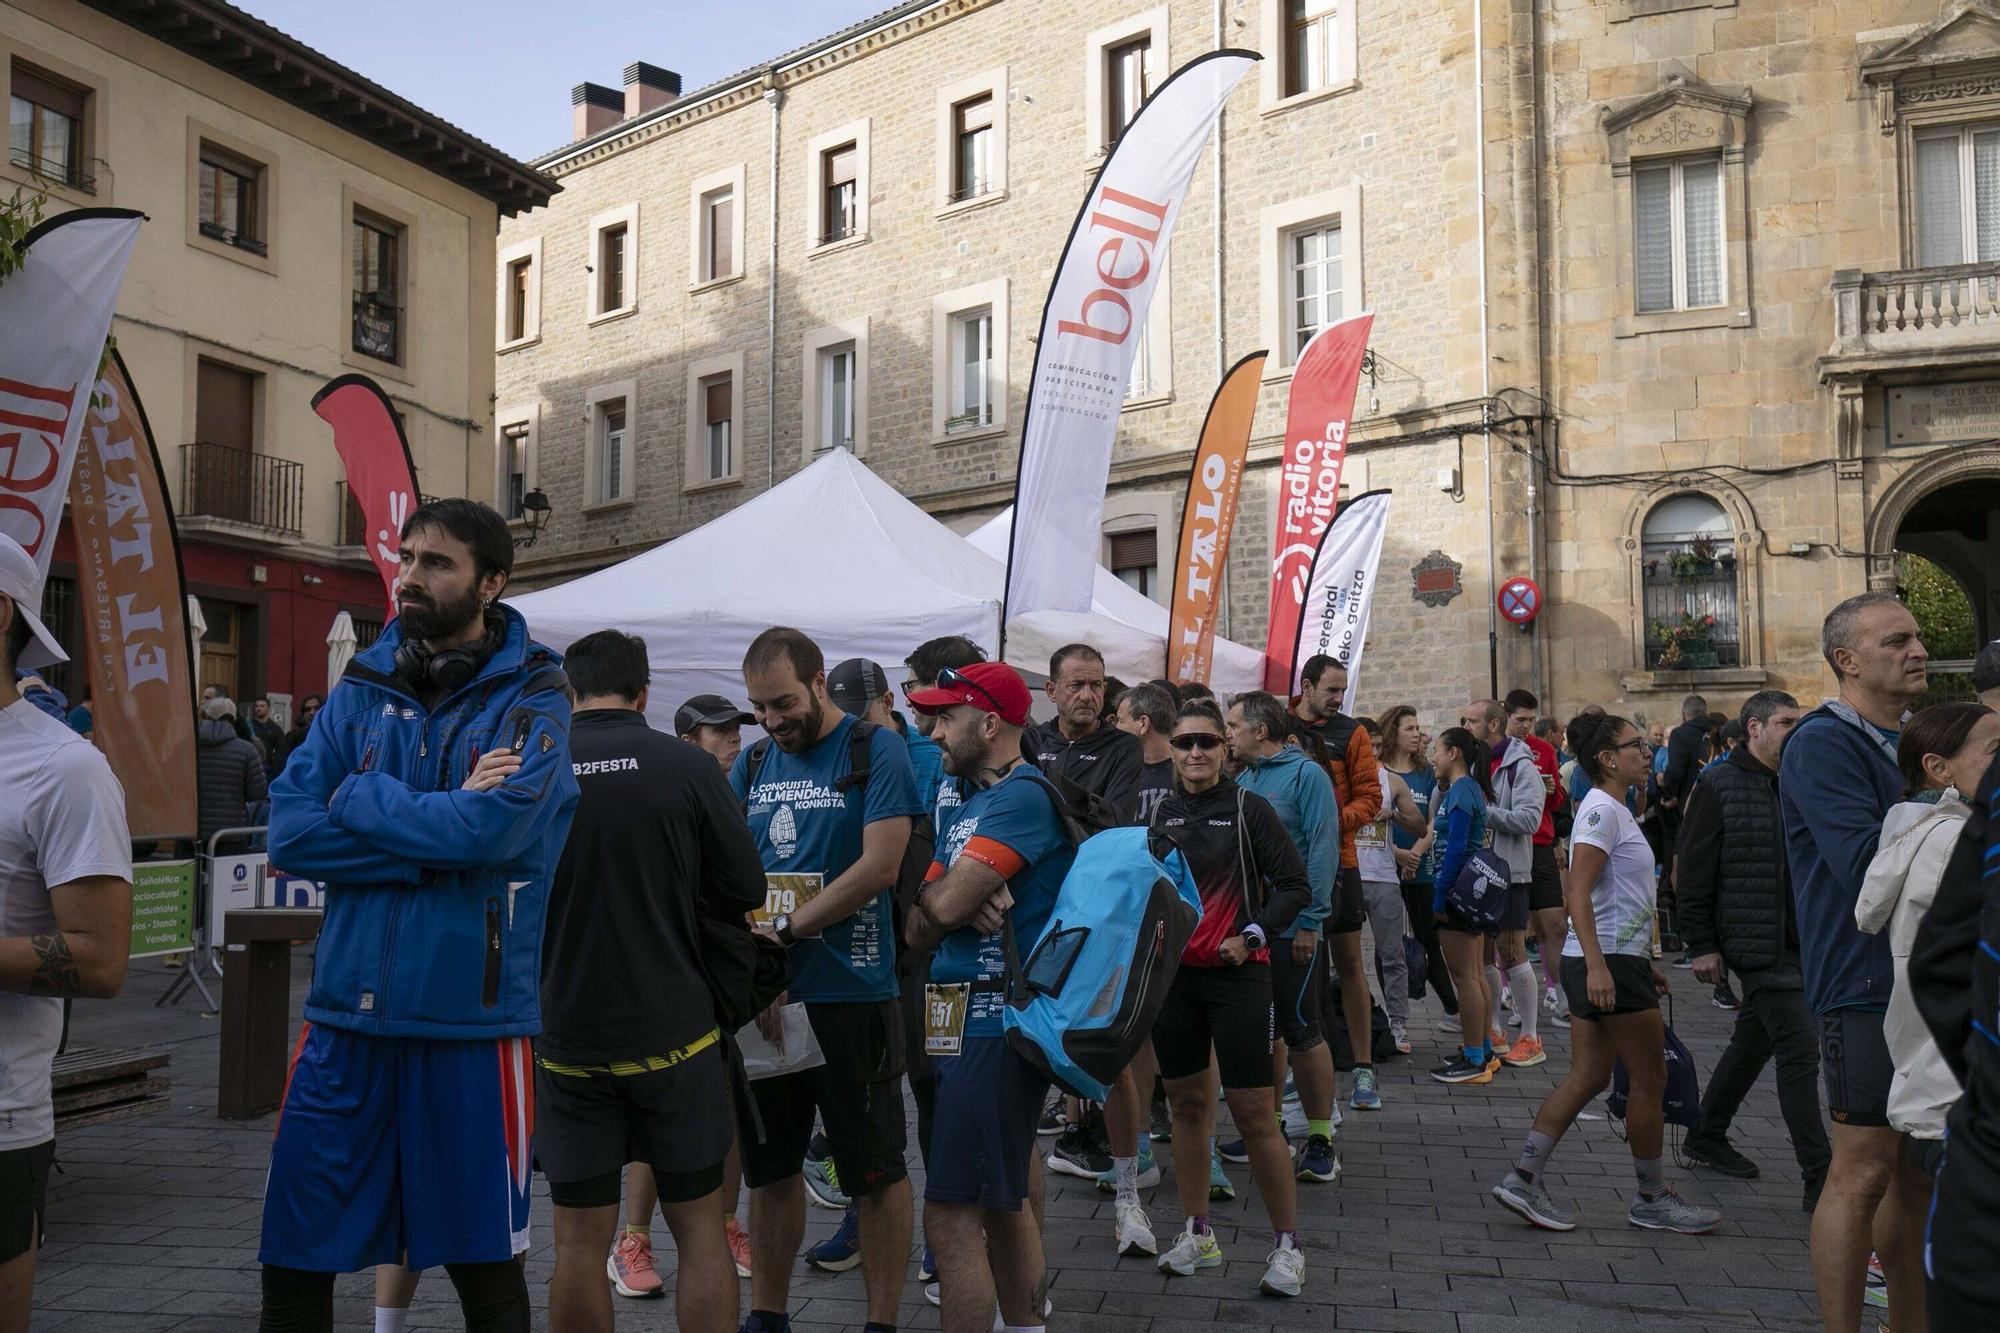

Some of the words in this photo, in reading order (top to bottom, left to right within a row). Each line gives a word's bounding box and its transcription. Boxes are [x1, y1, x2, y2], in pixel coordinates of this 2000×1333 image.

[1058, 186, 1172, 345] bell
[1285, 440, 1315, 534] radio
[1310, 420, 1346, 536] vitoria
[1187, 453, 1226, 603] TALO
[1347, 569, 1365, 624] gaitza
[1317, 585, 1339, 656] cerebral
[572, 758, 639, 775] B2FESTA
[758, 780, 813, 792] CONQUISTA
[758, 786, 831, 804] ALMENDRA
[794, 799, 846, 810] KONKISTA
[133, 889, 180, 902] ociocultural
[152, 918, 177, 929] Stands
[145, 934, 177, 944] Vending
[931, 1001, 954, 1029] 551
